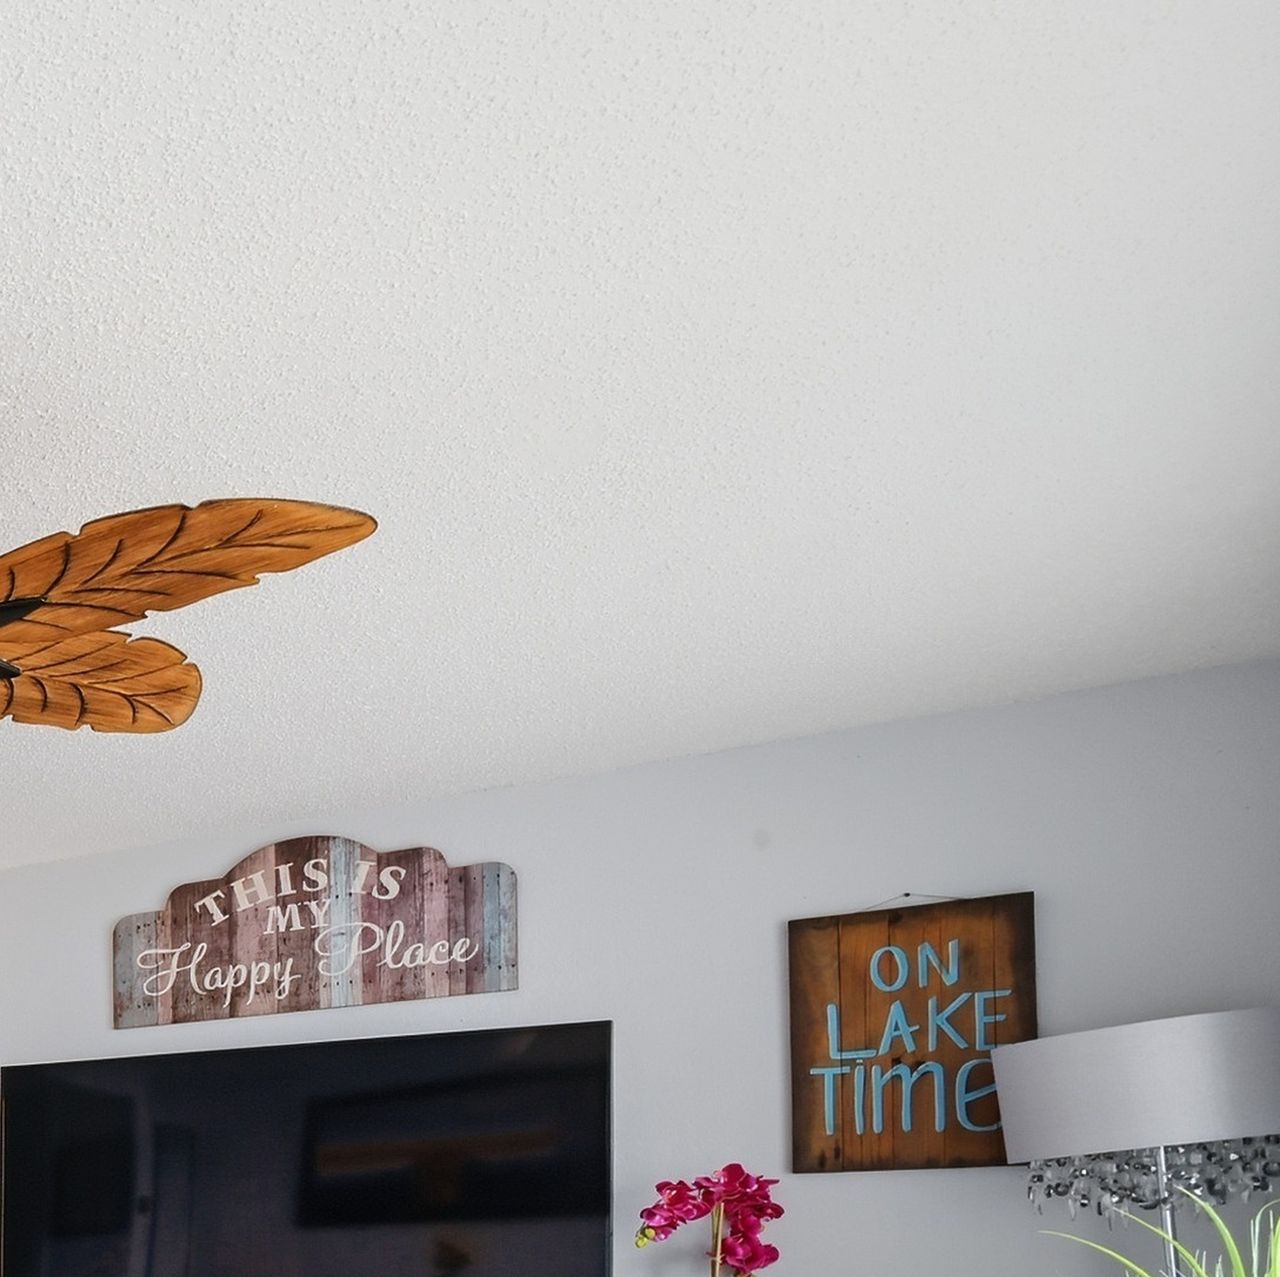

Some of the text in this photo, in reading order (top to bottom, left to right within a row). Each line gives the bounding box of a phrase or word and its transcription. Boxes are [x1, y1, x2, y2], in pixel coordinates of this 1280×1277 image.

[194, 857, 407, 927] THIS IS
[262, 898, 332, 935] MY
[136, 920, 480, 1008] Happy Place
[869, 938, 960, 993] ON
[826, 988, 1013, 1060] LAKE
